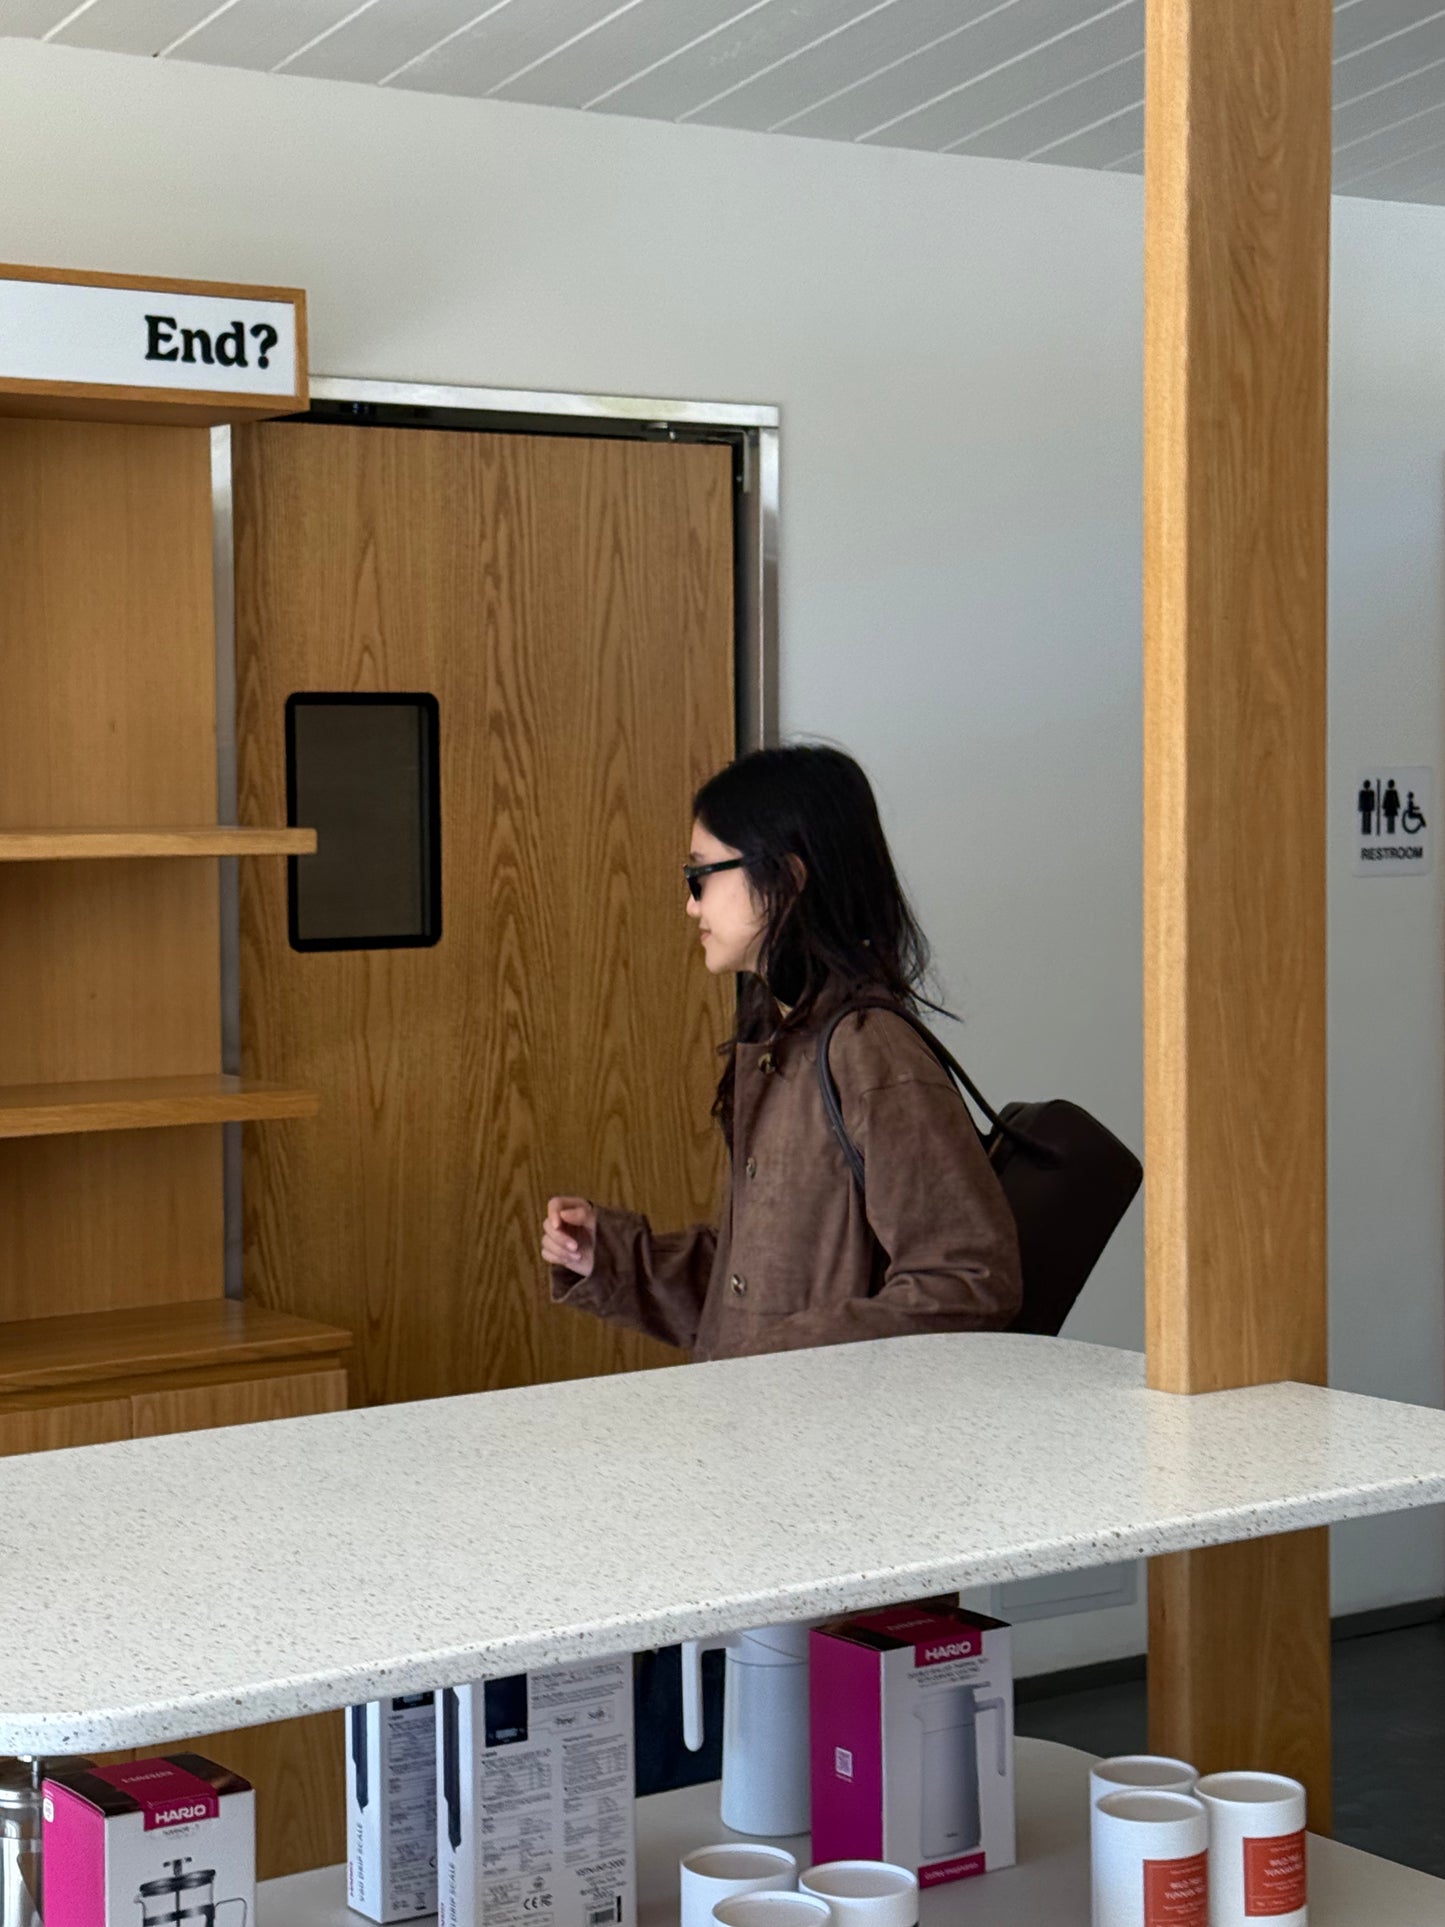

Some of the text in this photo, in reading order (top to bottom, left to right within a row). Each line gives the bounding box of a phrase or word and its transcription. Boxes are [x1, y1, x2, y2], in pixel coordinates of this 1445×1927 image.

[144, 315, 278, 370] End?
[1361, 846, 1423, 860] RESTROOM
[924, 1640, 972, 1661] HARIO
[154, 1803, 207, 1825] HARIO
[356, 1822, 364, 1855] SCALE
[448, 1862, 456, 1896] SCALE
